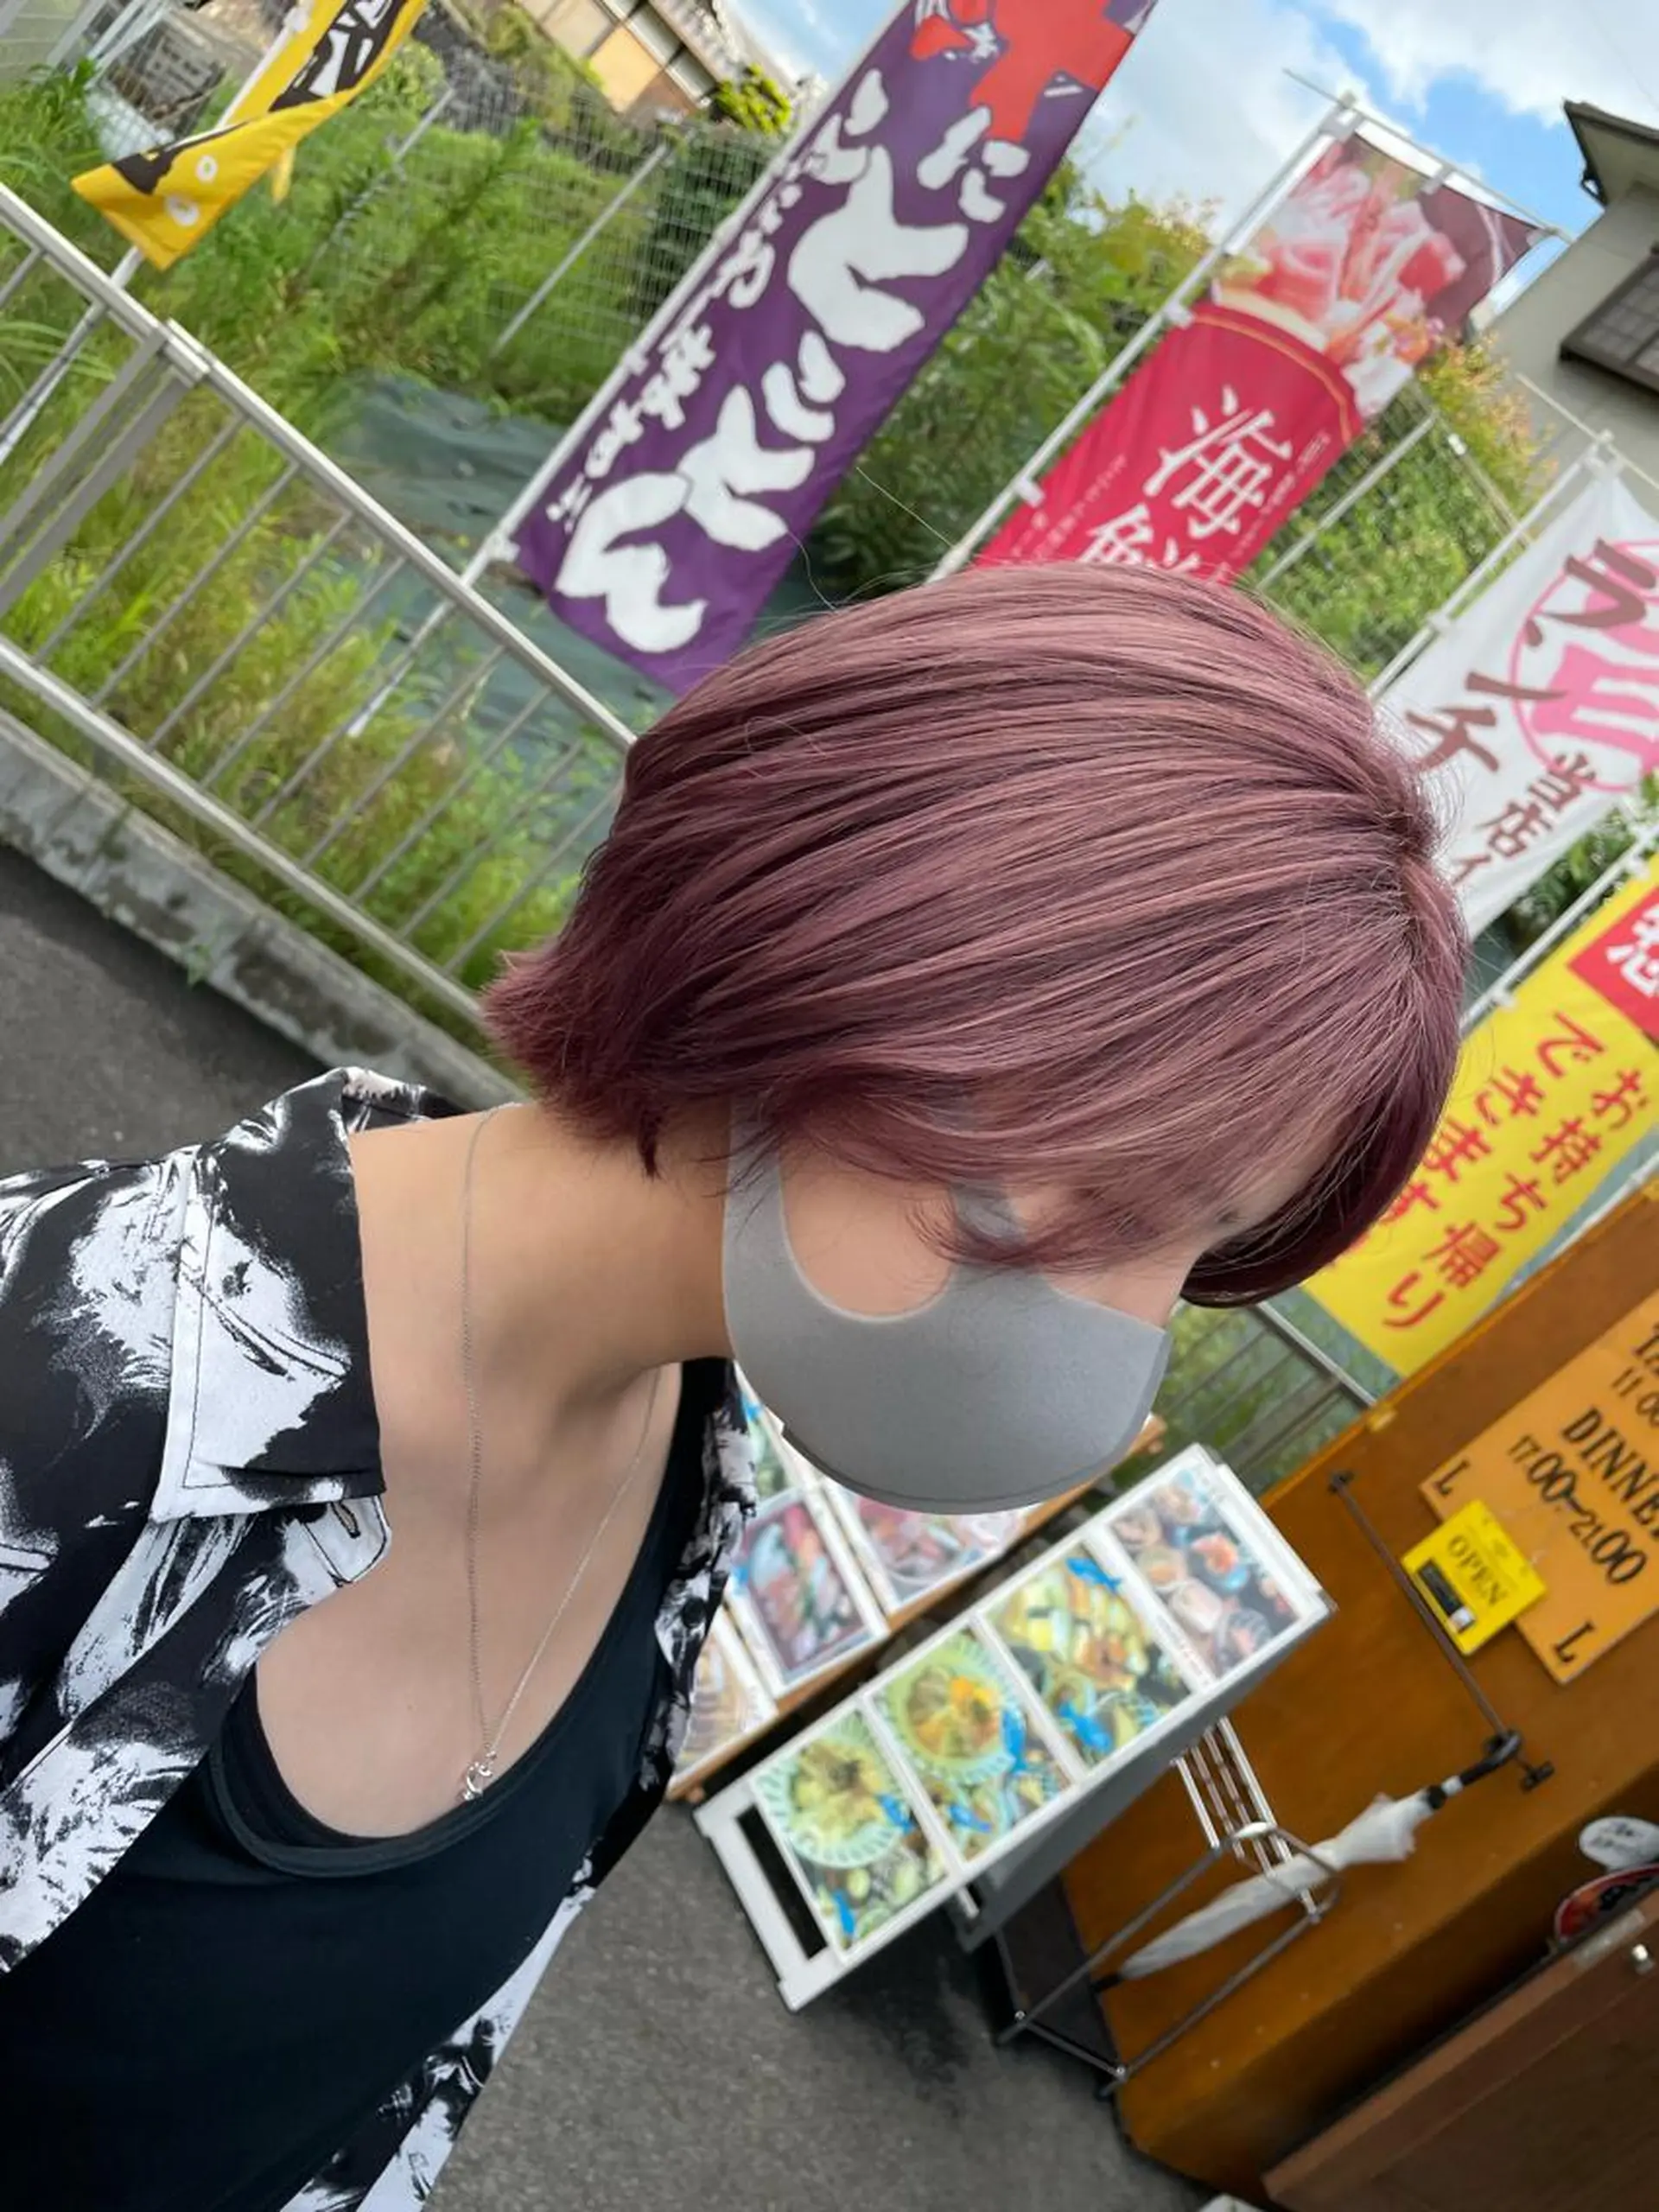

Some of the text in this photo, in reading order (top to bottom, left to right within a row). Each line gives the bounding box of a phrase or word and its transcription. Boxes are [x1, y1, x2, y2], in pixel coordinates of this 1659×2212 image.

[1405, 537, 1657, 772] ランチ
[1382, 1069, 1649, 1328] お持ち帰り
[1446, 1535, 1510, 1605] OPEN
